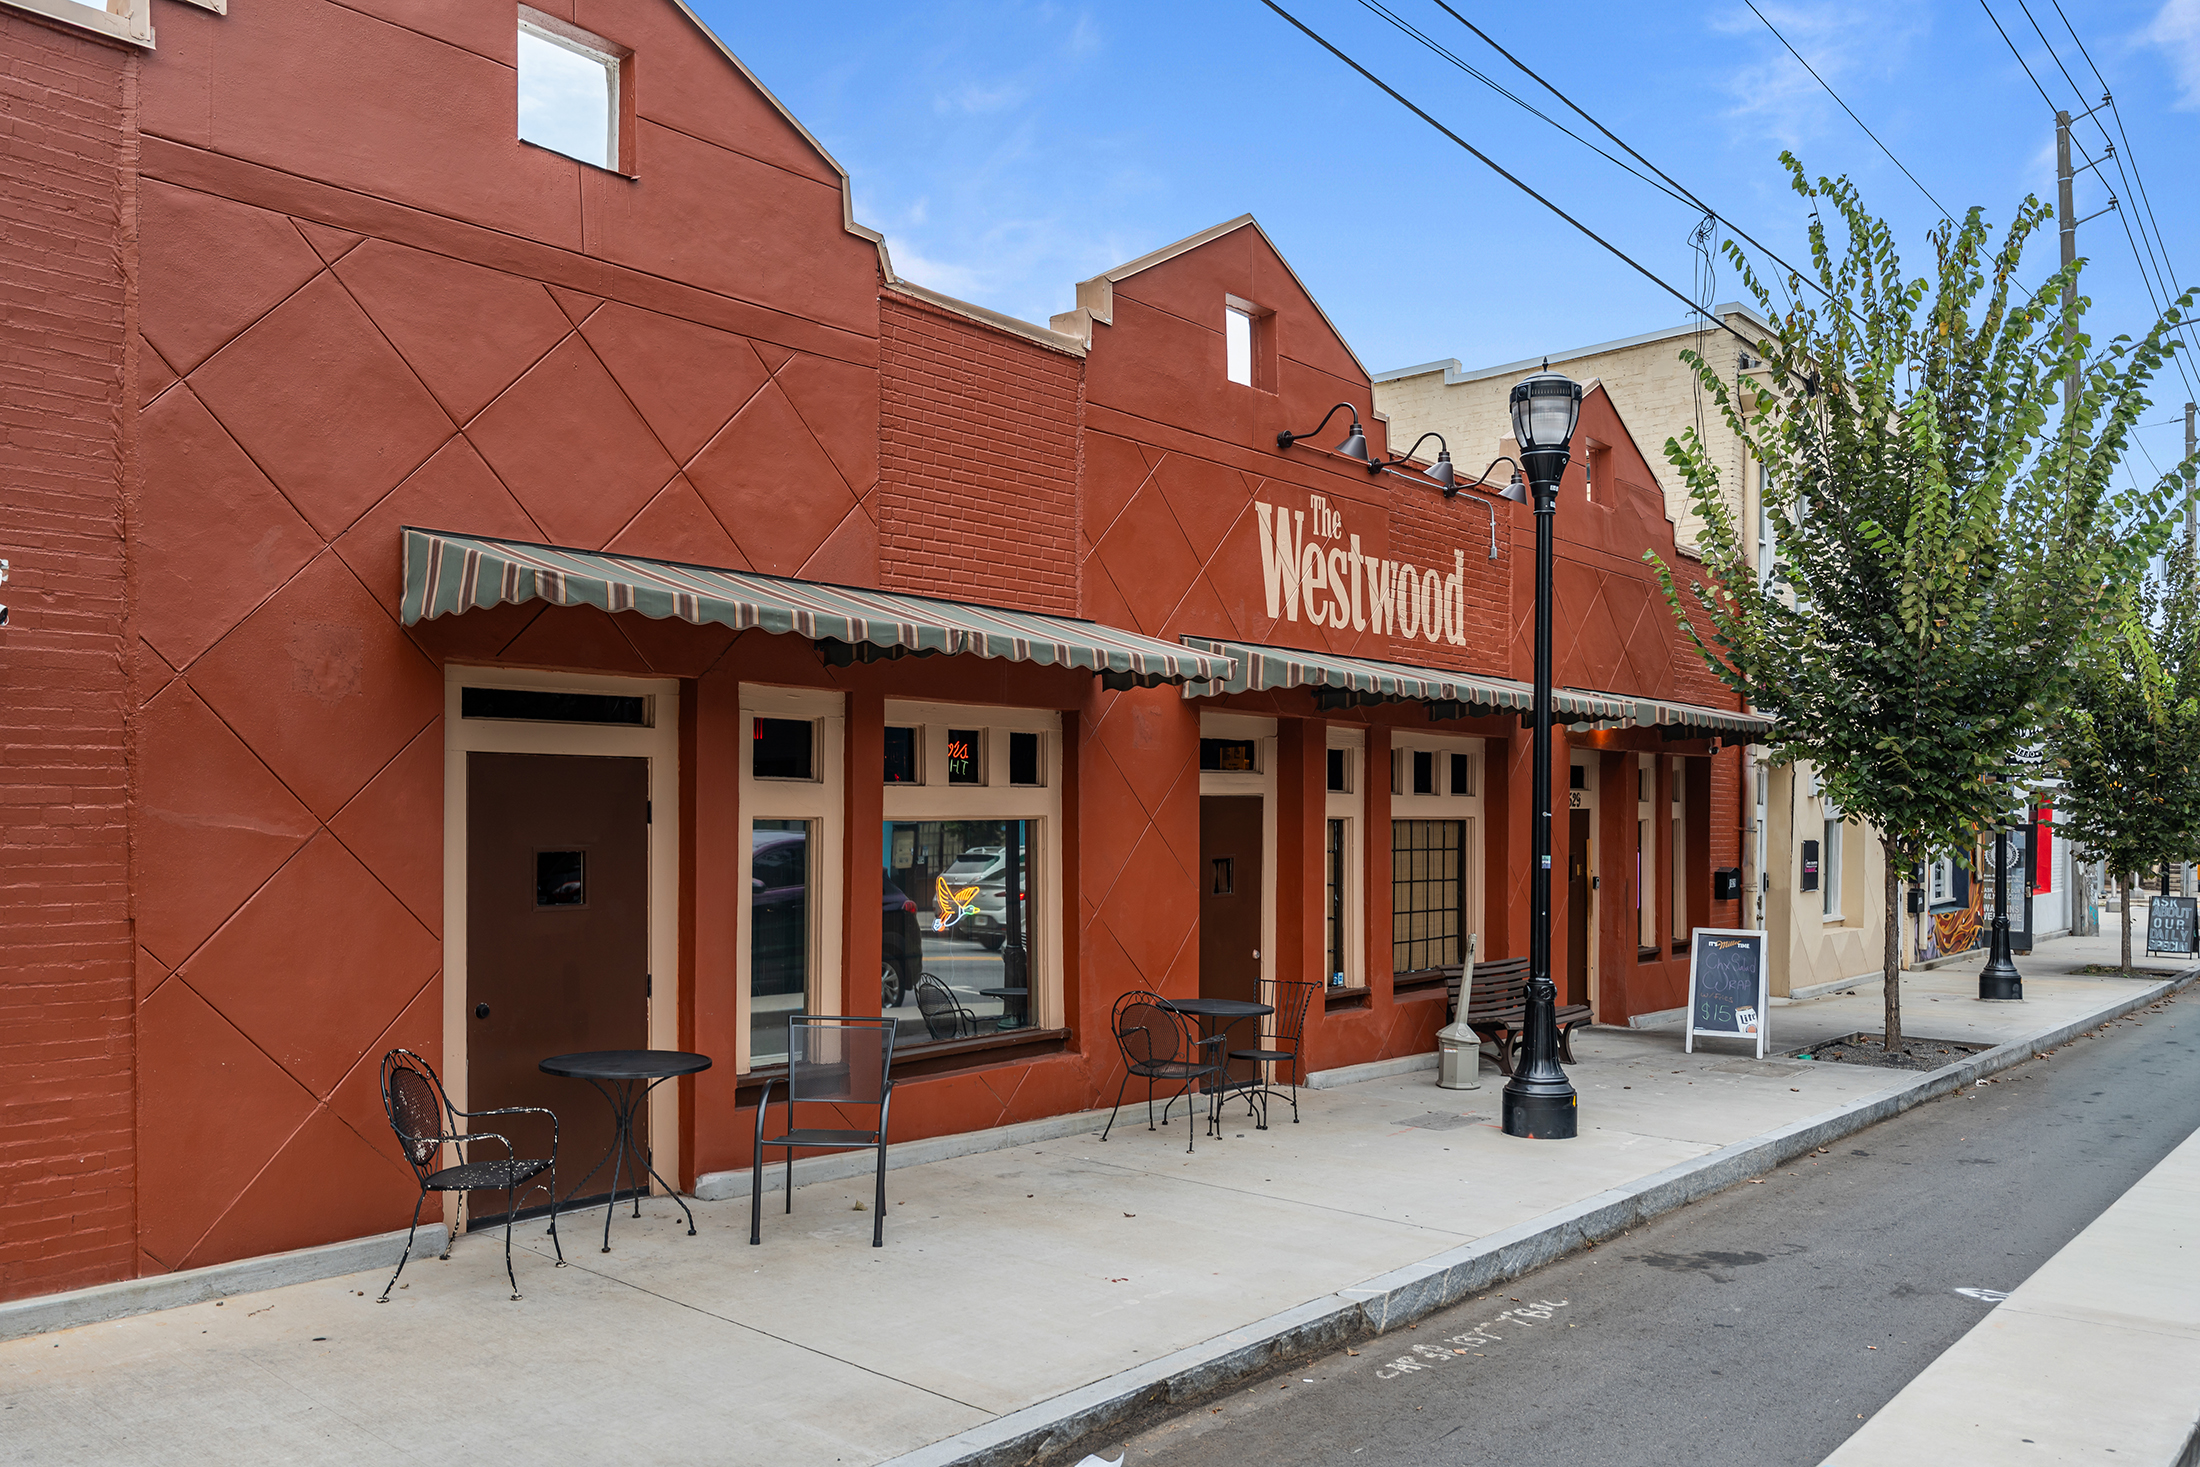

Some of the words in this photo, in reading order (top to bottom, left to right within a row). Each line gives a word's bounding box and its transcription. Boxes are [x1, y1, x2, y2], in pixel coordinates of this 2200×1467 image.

[1310, 494, 1342, 539] The
[1255, 500, 1466, 646] Westwood
[2152, 897, 2178, 907] ASK
[2152, 906, 2192, 919] ABOUT
[2153, 918, 2186, 930] OUR
[2150, 928, 2189, 941] DAILY
[2148, 940, 2191, 952] SPECIAL
[1701, 1001, 1732, 1022] $15
